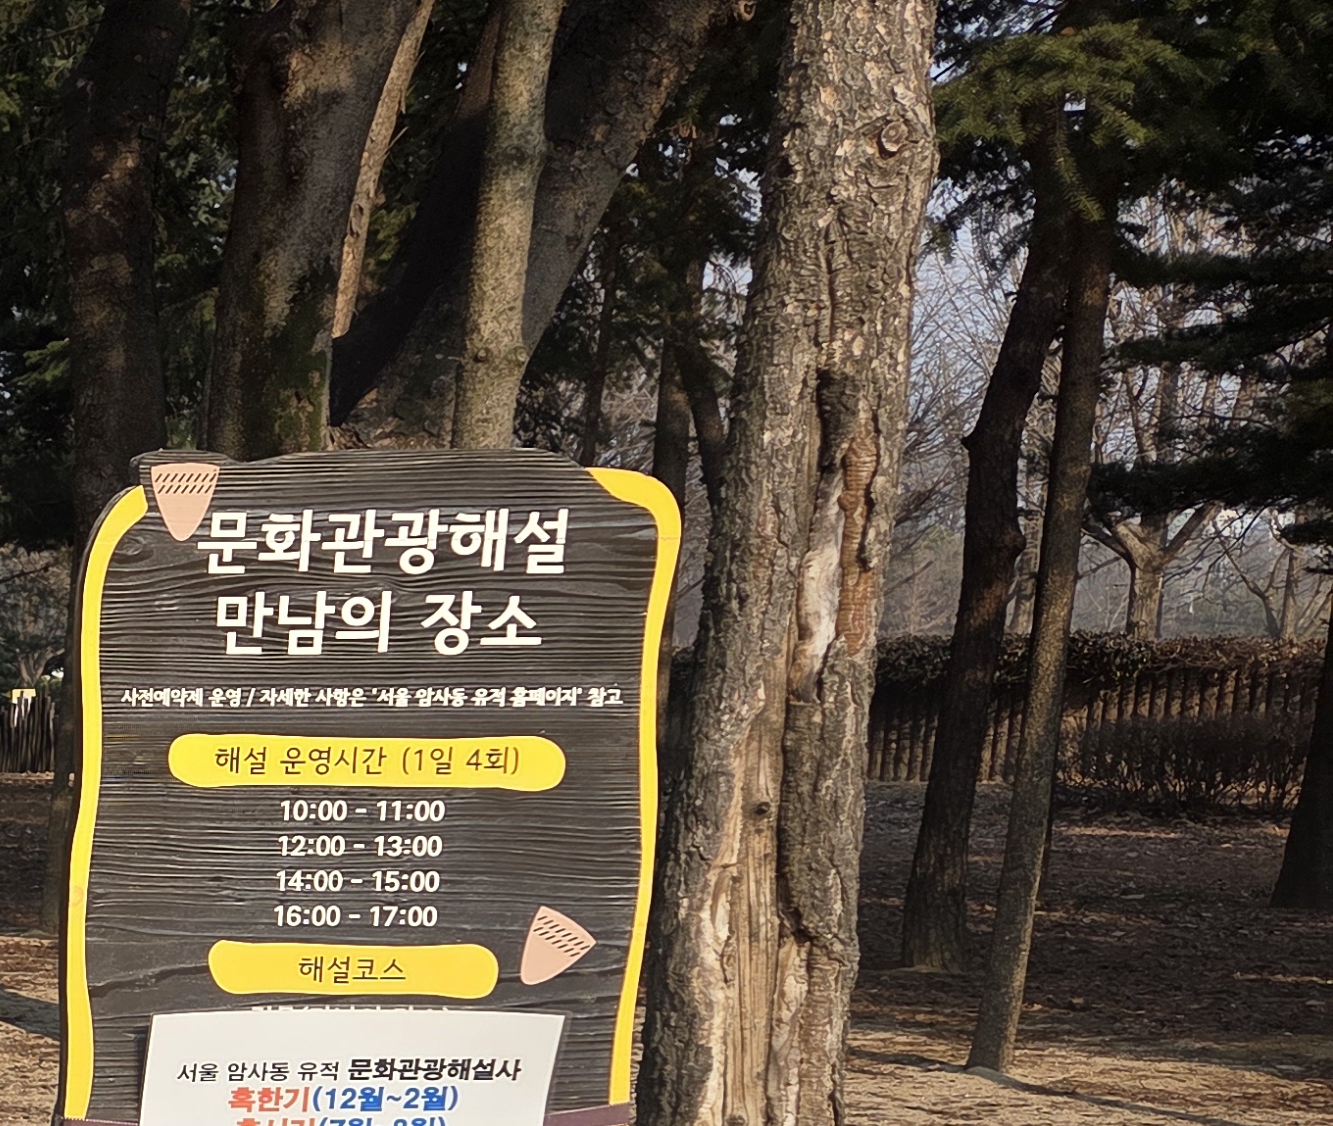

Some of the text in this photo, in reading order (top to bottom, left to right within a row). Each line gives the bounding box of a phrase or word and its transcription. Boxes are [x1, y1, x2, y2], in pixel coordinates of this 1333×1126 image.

[197, 508, 569, 575] 문화관광해설
[216, 590, 542, 655] 만남의 장소
[121, 687, 204, 708] 사전예약제
[208, 687, 242, 708] 운영
[259, 688, 311, 708] 자세한
[314, 688, 364, 707] 사항은
[414, 687, 468, 707] 암사동
[470, 687, 506, 707] 유적
[587, 687, 624, 707] 참고
[214, 746, 520, 776] 해설 운영시간 (1일 4회)
[280, 799, 348, 822] 10:00
[376, 800, 446, 822] 11:00
[277, 835, 346, 857] 12:00
[373, 835, 443, 857] 13:00
[275, 870, 344, 892] 14:00
[371, 870, 441, 893] 15:00
[273, 905, 342, 927] 16:00
[369, 905, 438, 927] 17:00
[298, 956, 407, 984] 해설코스
[177, 1058, 522, 1082] 서울 암사동 유적 문화관광해설사
[228, 1085, 460, 1113] 혹한기(12월~2월)
